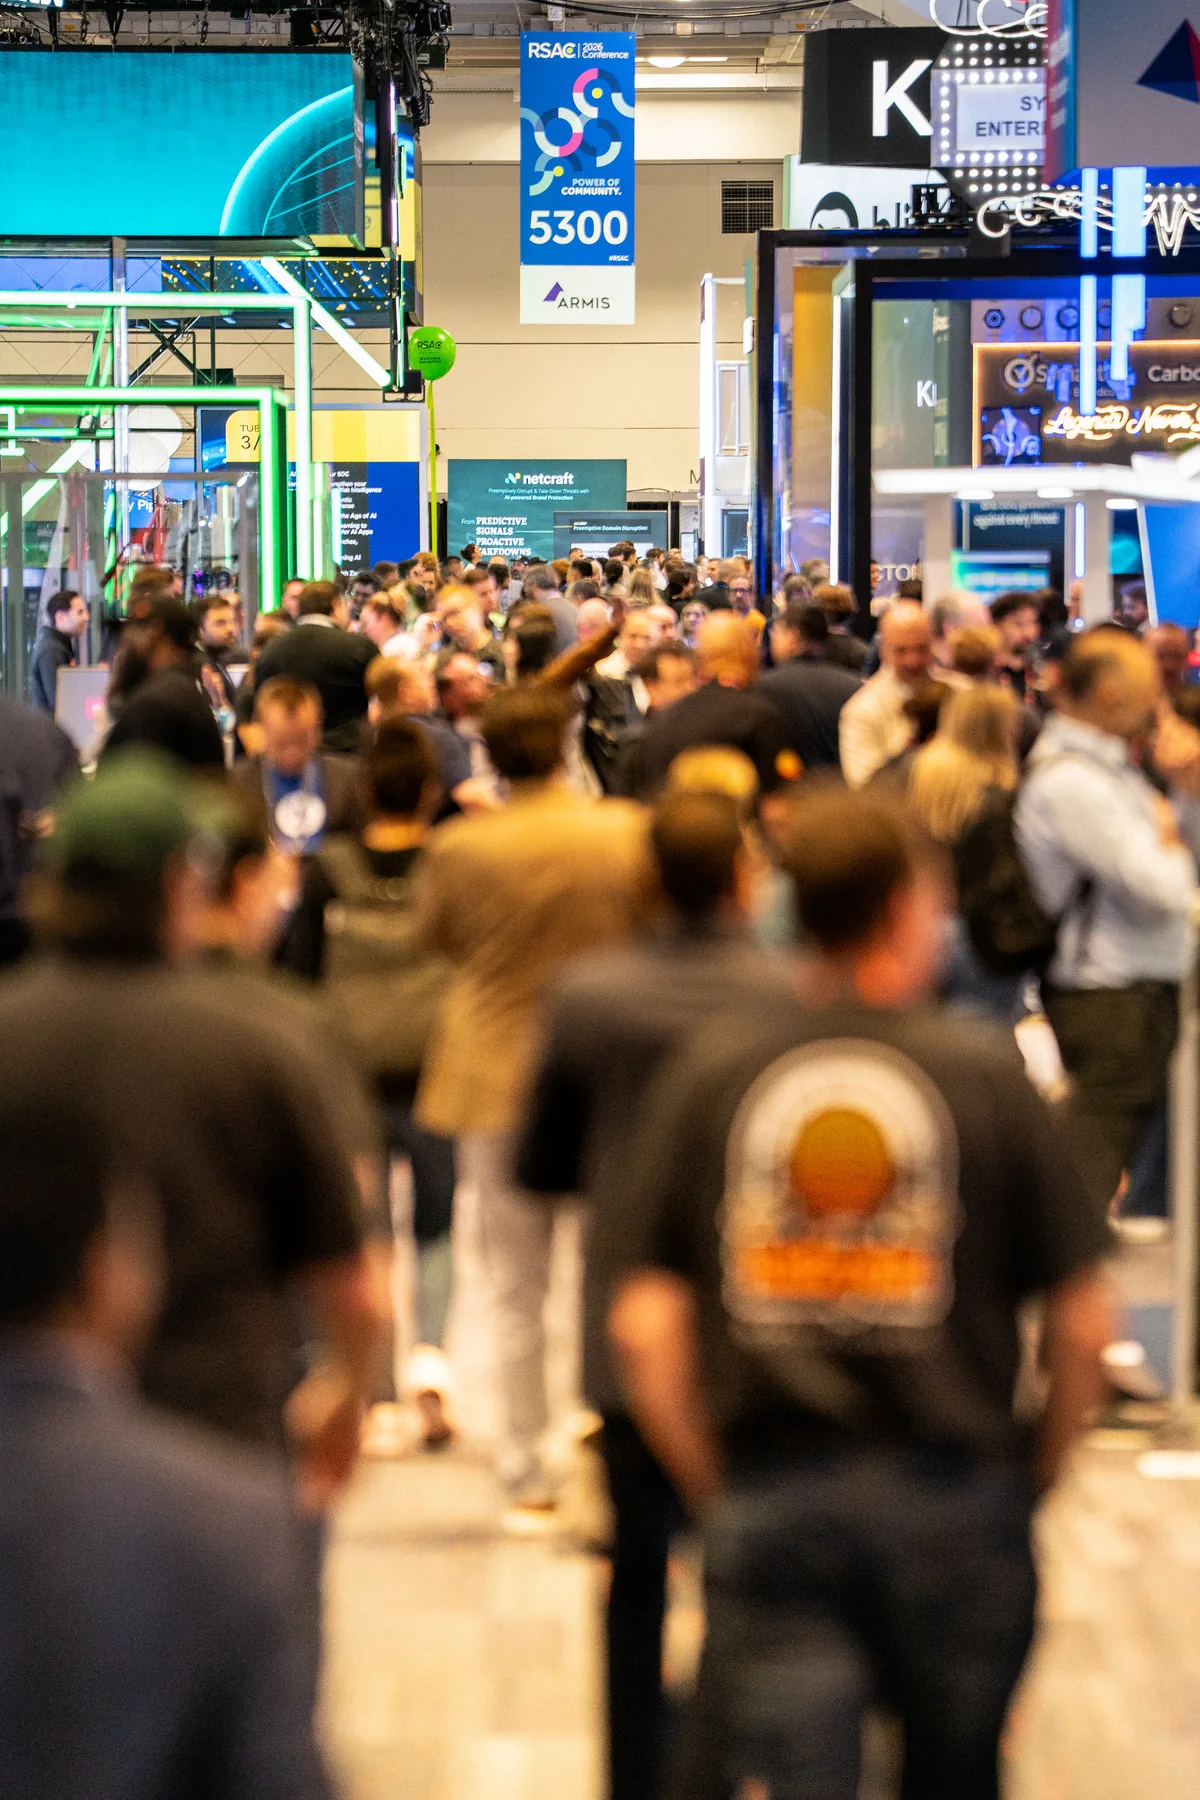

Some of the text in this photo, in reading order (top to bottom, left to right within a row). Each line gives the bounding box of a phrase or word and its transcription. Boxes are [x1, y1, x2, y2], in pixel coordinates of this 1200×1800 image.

[528, 42, 576, 58] RSAC
[582, 42, 603, 51] 2026
[582, 51, 629, 59] Conference
[975, 120, 1045, 137] ENTER
[572, 178, 620, 187] POWER OF
[561, 187, 622, 196] COMMUNITY.
[529, 210, 628, 245] 5300
[557, 297, 611, 309] ARMIS
[417, 340, 443, 350] RSAC
[523, 471, 574, 485] netcraft
[476, 517, 527, 525] PREDICTIVE
[476, 527, 514, 535] SIGNALS
[476, 537, 525, 546] PROACTIVE
